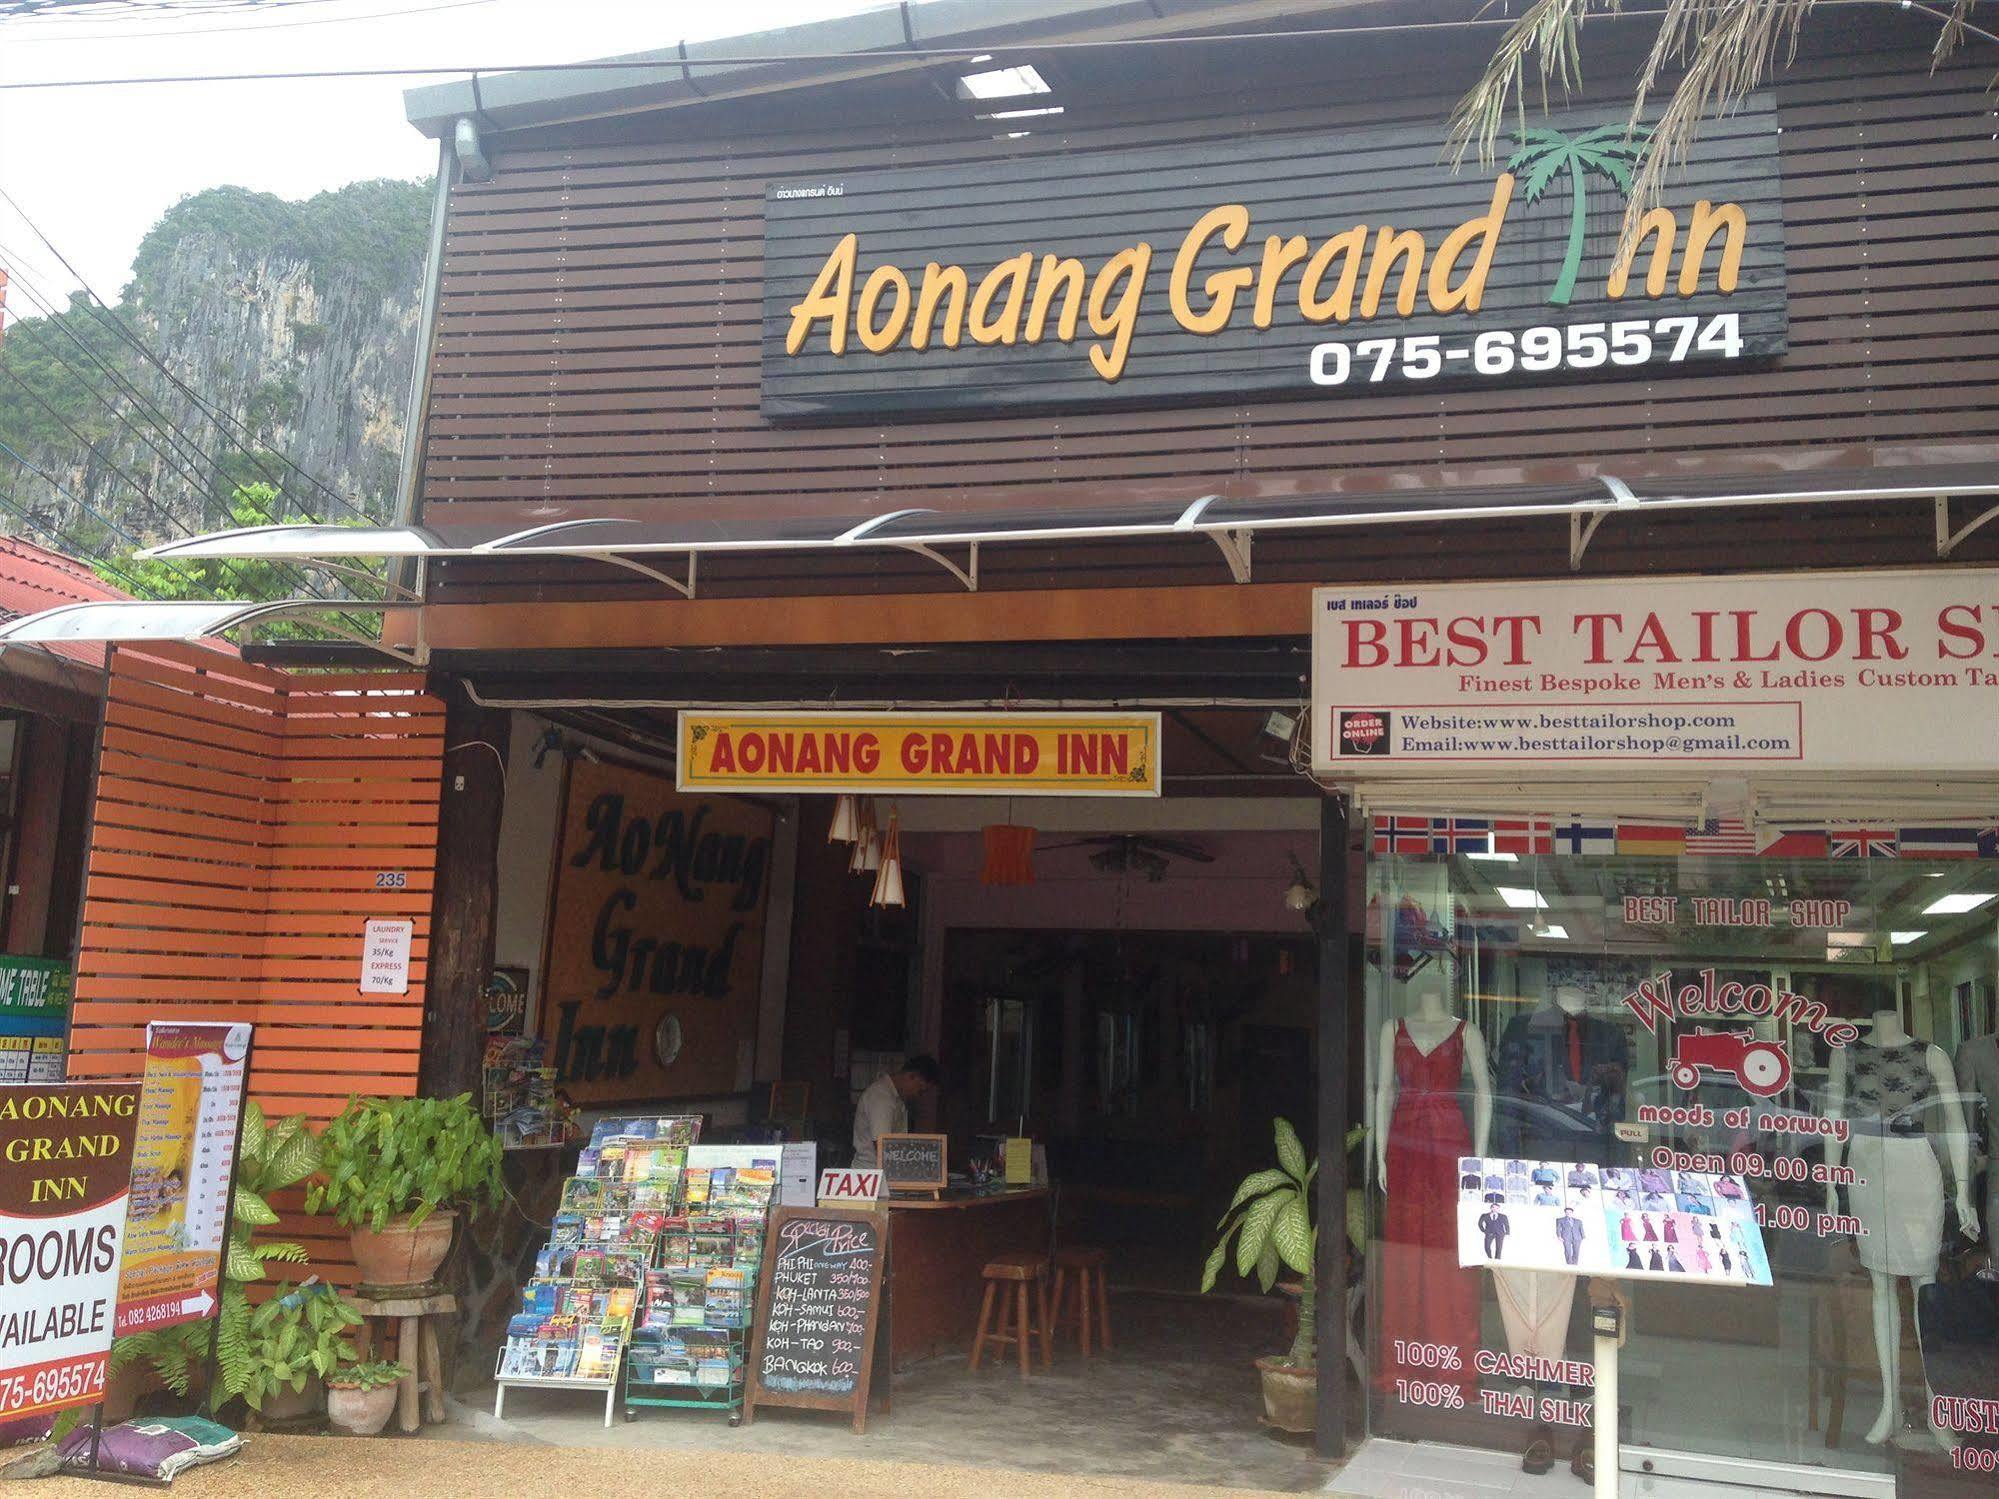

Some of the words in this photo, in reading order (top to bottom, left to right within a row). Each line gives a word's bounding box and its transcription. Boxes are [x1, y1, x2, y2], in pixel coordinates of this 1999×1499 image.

[787, 233, 1152, 384] Aonang
[1169, 172, 1515, 335] Grand
[1309, 314, 1744, 386] 075-695574
[1340, 615, 1541, 668] BEST
[1573, 608, 1909, 664] TAILOR
[1937, 604, 1999, 659] S
[1458, 673, 1532, 692] Finest
[1540, 672, 1641, 694] Bespoke
[1732, 671, 1752, 689] &
[1760, 669, 1845, 688] Ladies
[1858, 667, 1958, 687] Custom
[1343, 728, 1384, 739] ONLINE
[1344, 719, 1383, 728] ORDER
[710, 732, 880, 774] AONANG
[901, 732, 1039, 774] GRAND
[1058, 733, 1128, 774] INN
[376, 873, 405, 887] 235
[1623, 896, 1677, 923] BEST
[1692, 898, 1770, 927] TAILOR
[1791, 900, 1849, 928] SHOP
[592, 888, 745, 998] Grand
[371, 961, 402, 970] EXPRESS
[17, 969, 50, 1007] TABLE
[1621, 968, 1859, 1048] Welcome
[555, 1000, 640, 1083] Inn
[0, 1095, 136, 1120] AONANG
[1638, 1104, 1714, 1127] moods
[1724, 1110, 1750, 1128] of
[1759, 1114, 1849, 1142] norway
[6, 1135, 120, 1162] GRAND
[885, 1150, 938, 1162] WELCOME
[1652, 1146, 1725, 1174] Open
[1731, 1153, 1807, 1181] 09.00
[1812, 1165, 1867, 1186] am.
[29, 1176, 88, 1202] INN
[824, 1173, 878, 1197] TAXI
[1817, 1213, 1869, 1237] pm.
[0, 1224, 116, 1285] OOMS
[797, 1256, 813, 1269] PHI
[775, 1271, 817, 1284] PHUKET
[0, 1299, 106, 1348] AILABLE
[128, 1308, 144, 1326] 082
[146, 1300, 180, 1322] 4268194
[762, 1355, 828, 1376] BANGKOK
[1394, 1340, 1462, 1371] 100%
[1397, 1380, 1464, 1409] 100%
[1480, 1389, 1534, 1419] THAI
[1540, 1397, 1592, 1427] SILK
[1932, 1395, 1999, 1434] CUST
[1950, 1446, 1999, 1472] 100
